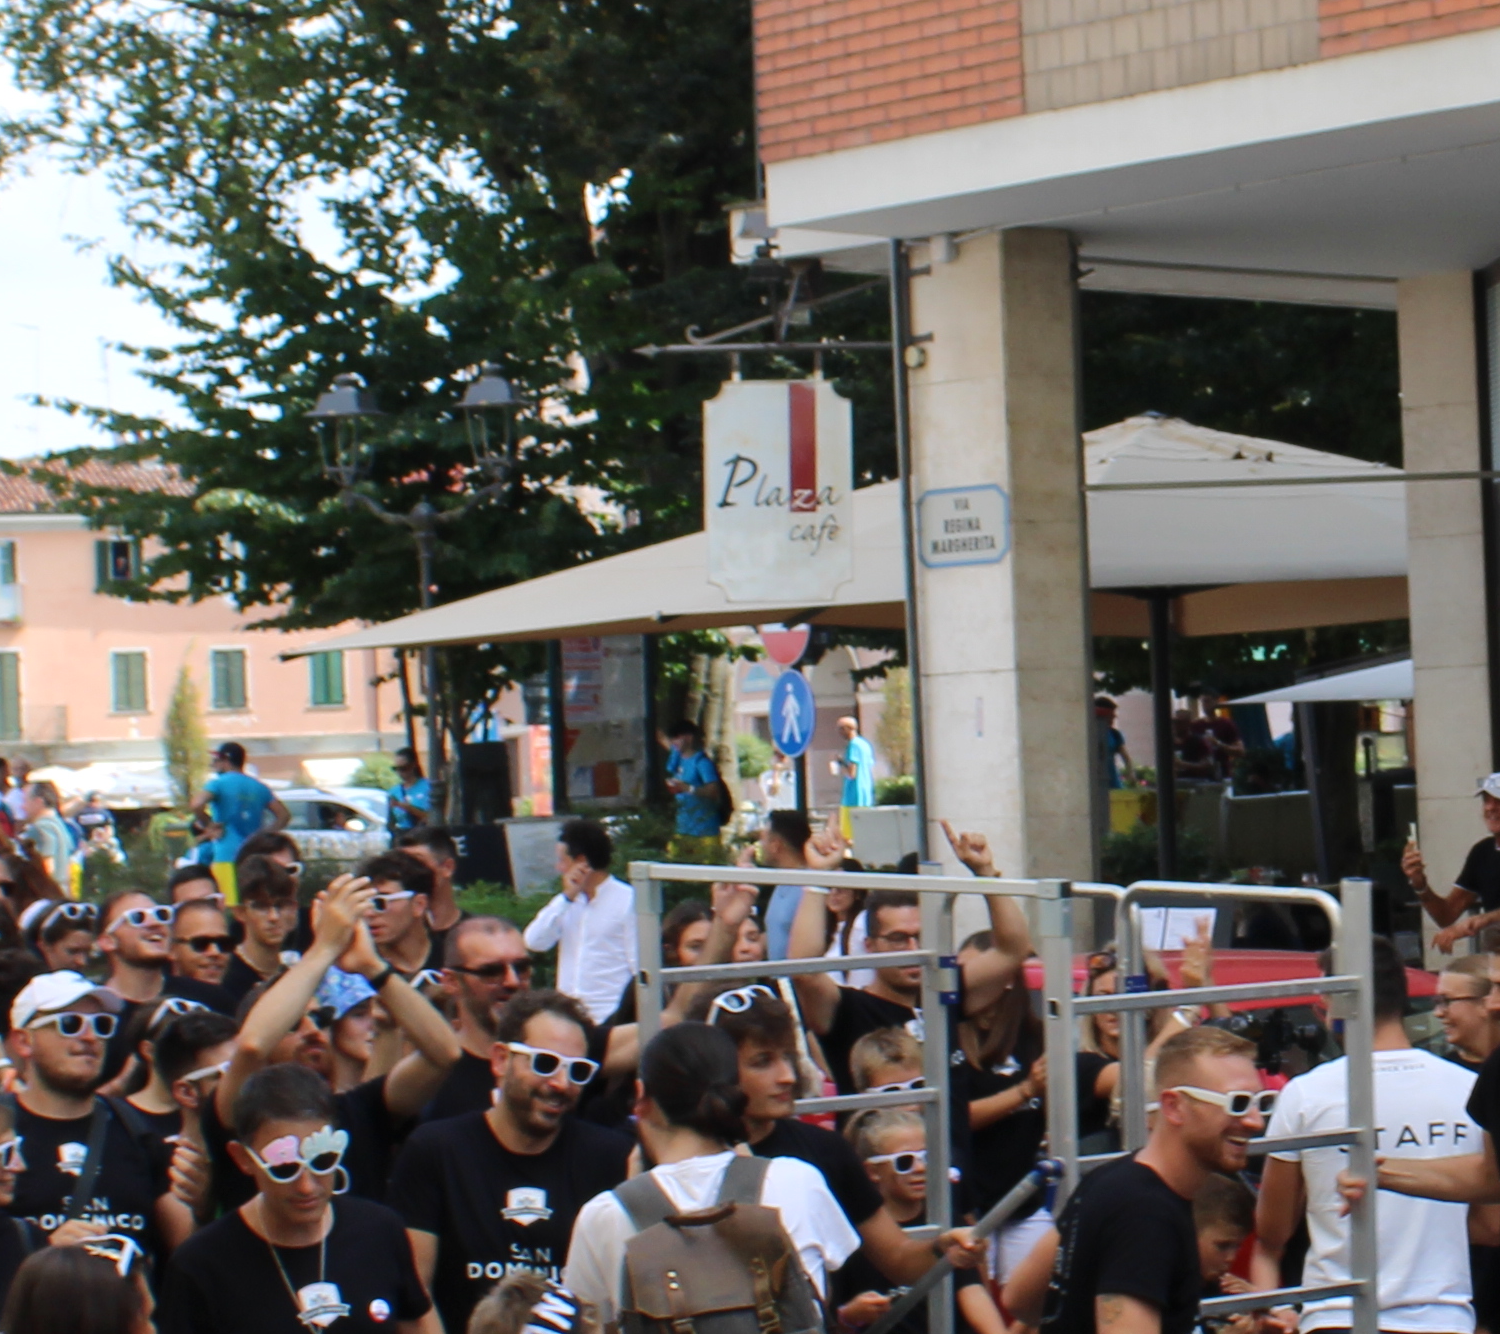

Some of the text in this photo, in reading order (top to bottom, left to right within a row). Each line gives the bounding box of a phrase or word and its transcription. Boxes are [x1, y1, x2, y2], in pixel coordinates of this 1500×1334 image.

[717, 454, 842, 508] Plaza
[954, 496, 970, 510] VIA
[944, 517, 981, 534] REGINA
[931, 535, 996, 555] MARGHERITA
[1338, 1122, 1469, 1154] TAFF
